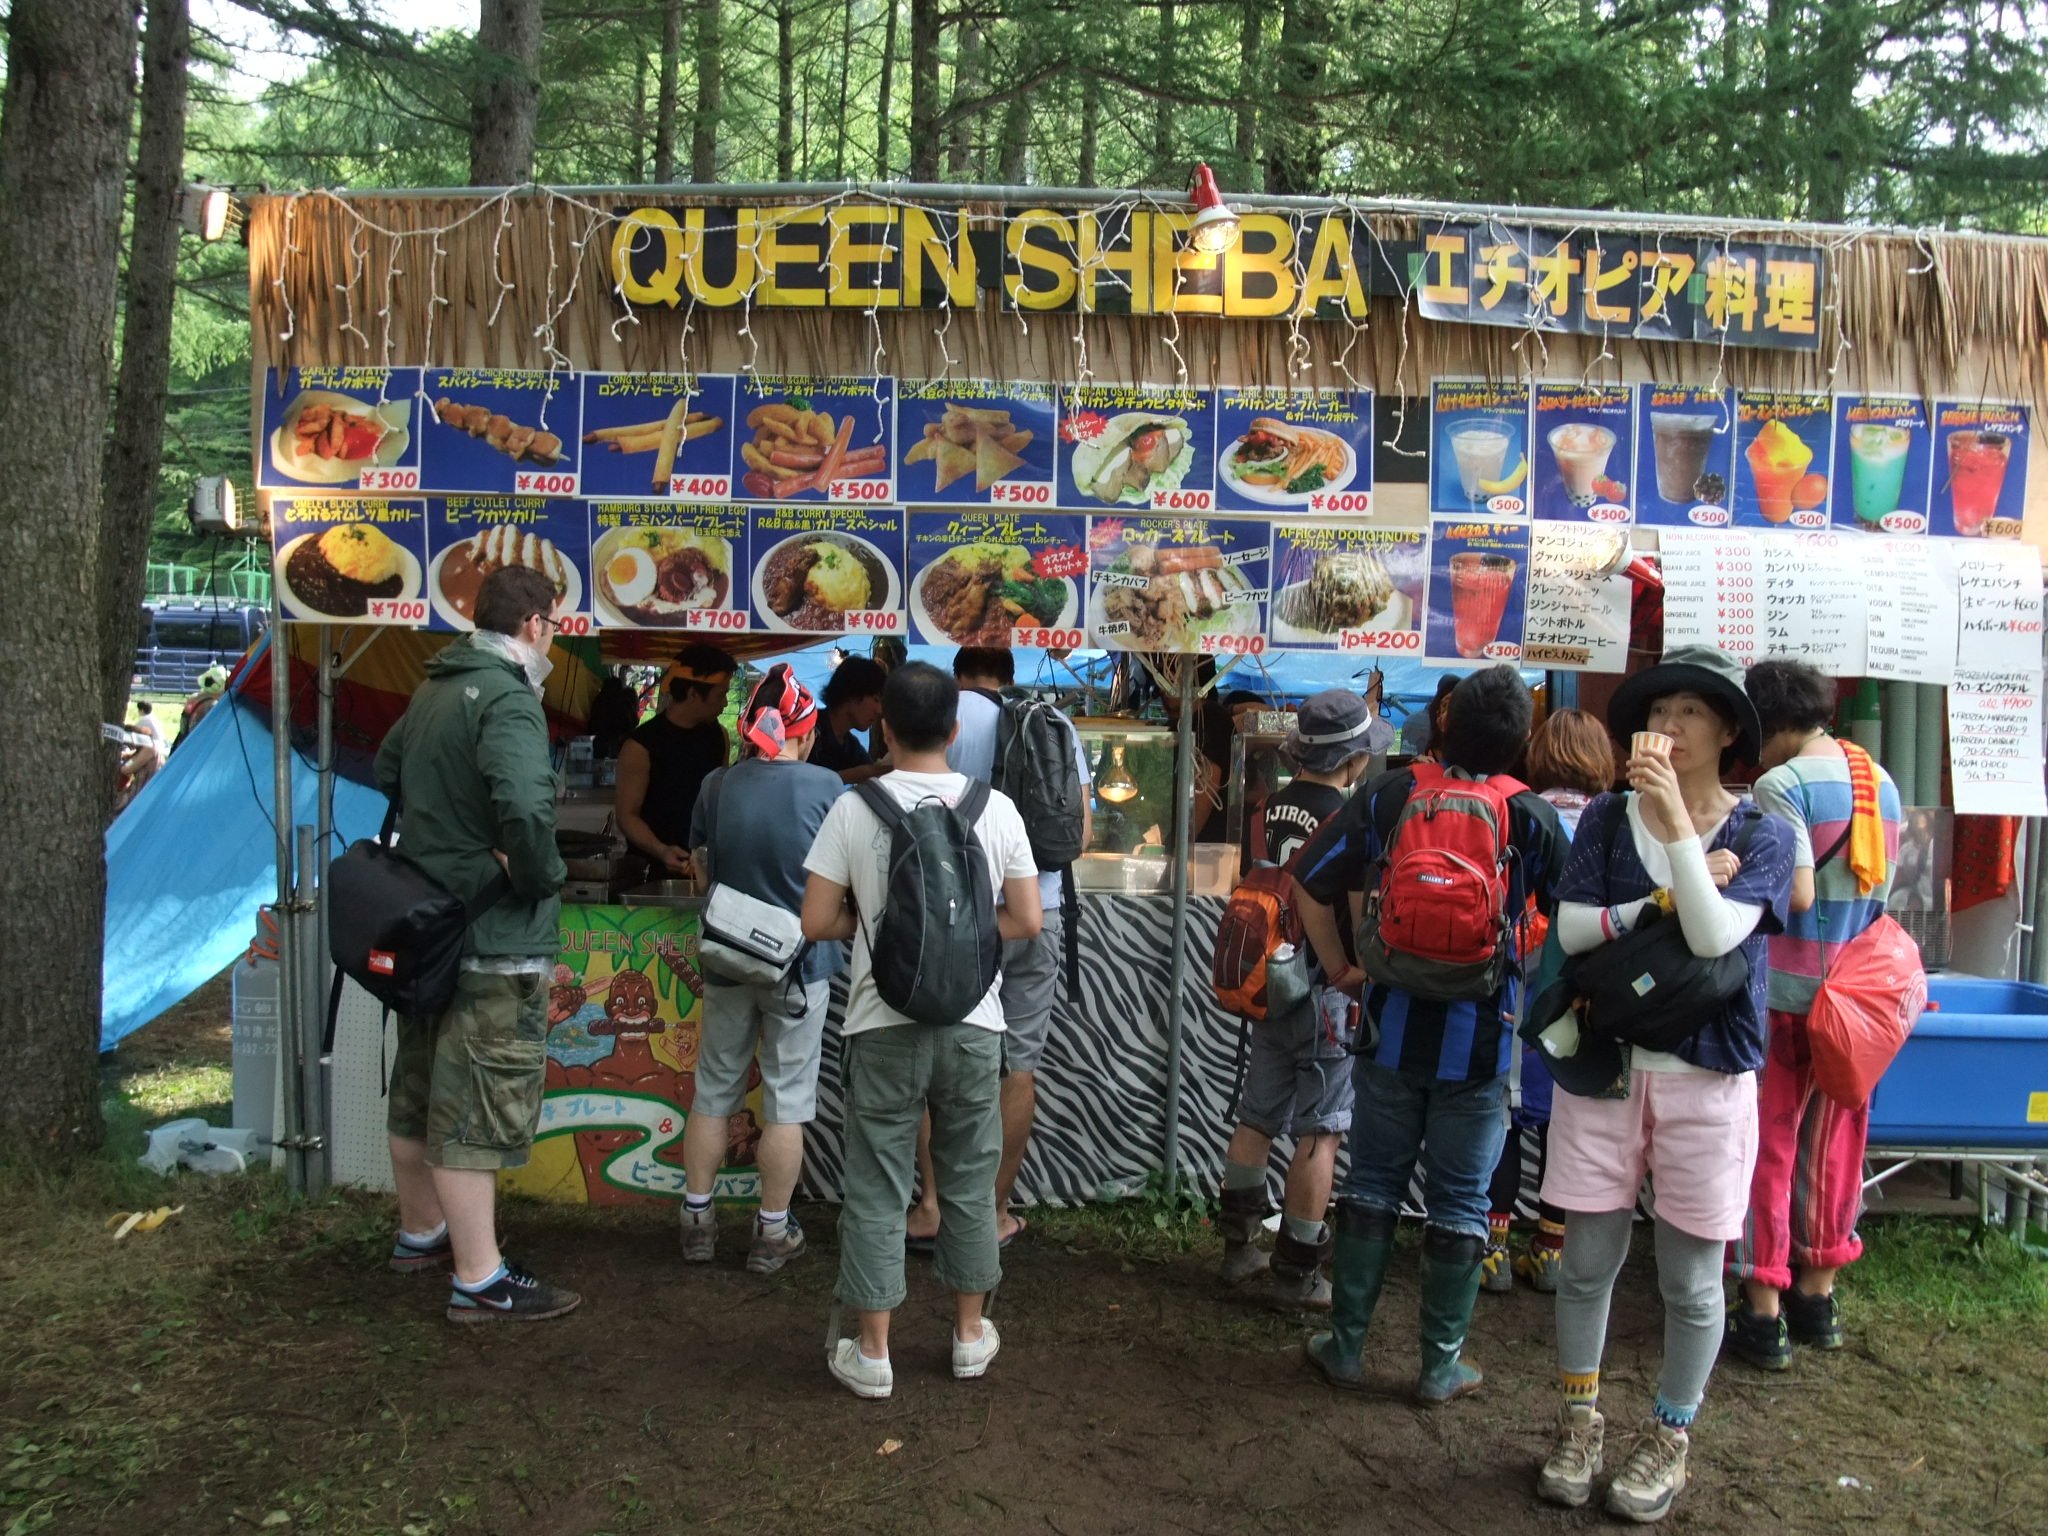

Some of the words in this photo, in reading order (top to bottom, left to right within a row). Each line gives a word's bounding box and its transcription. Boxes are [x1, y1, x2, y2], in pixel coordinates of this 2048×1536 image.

[612, 207, 976, 309] QUEEN
[1003, 208, 1369, 317] SHEBA
[1424, 233, 1816, 334] エチオピア料理
[299, 367, 338, 376] GARLIC
[453, 368, 477, 377] SPICY
[479, 368, 515, 378] CHICKEN
[299, 376, 385, 389] ガーリックポテト
[608, 375, 632, 385] LONG
[635, 376, 675, 385] SAUSAGE
[1111, 388, 1148, 397] OSTRICH
[1152, 389, 1171, 398] PITA
[1238, 390, 1275, 399] AFRICAN
[1302, 391, 1337, 400] BUGER
[1286, 411, 1358, 422] &ガーリックポテト
[362, 472, 417, 490] ¥300
[518, 475, 575, 493] ¥400
[672, 478, 726, 496] ¥400
[831, 482, 888, 499] ¥500
[993, 484, 1049, 502] ¥500
[447, 497, 470, 507] BEEF
[474, 497, 510, 508] CUTLET
[515, 498, 546, 508] CURRY
[1153, 491, 1210, 510] ¥600
[1311, 494, 1368, 511] ¥600
[446, 509, 549, 523] ビーフカツカリー
[598, 504, 641, 513] HAMBURG
[644, 504, 672, 513] STEAK
[676, 505, 697, 513] WITH
[701, 506, 725, 515] FRIED
[728, 507, 746, 515] EGG
[775, 508, 794, 518] R&B
[797, 509, 827, 518] CURRY
[830, 509, 866, 519] SPECIAL
[1591, 510, 1626, 521] ¥500
[597, 514, 621, 526] 特製
[629, 514, 745, 527] デミハンバーグプレート
[961, 514, 989, 523] QUEEN
[994, 514, 1020, 523] PLATE
[1692, 511, 1725, 523] ¥500
[1883, 516, 1921, 530] ¥500
[947, 520, 1046, 537] クィーンプレート
[1141, 519, 1180, 530] ROCKER'S
[1183, 520, 1208, 531] PLATE
[1983, 520, 2021, 535] ¥600
[1279, 528, 1335, 541] AFRICAN
[1339, 529, 1420, 543] DOUGHNUTS
[1291, 539, 1338, 551] アフリカン
[1042, 550, 1074, 565] オススメ
[1223, 548, 1268, 565] ソーセージ
[1714, 547, 1751, 557] ¥300
[1764, 549, 1793, 558] カシス
[1716, 562, 1752, 572] ¥300
[1766, 563, 1805, 573] カンパリ
[1716, 577, 1753, 587] ¥300
[1767, 578, 1794, 588] ディタ
[1224, 590, 1269, 603] ビーフカツ
[1531, 584, 1599, 597] グレープフルーツ
[1717, 592, 1753, 603] ¥300
[1868, 599, 1893, 608] VODKA
[1962, 596, 2010, 609] 生ビール
[371, 601, 424, 619] ¥700
[1529, 599, 1612, 615] ジンジャーエール
[1718, 608, 1754, 619] ¥300
[688, 610, 746, 629] ¥700
[848, 611, 897, 629] ¥900
[1768, 610, 1788, 621] ジン
[1098, 622, 1129, 635] 牛焼肉
[1528, 617, 1585, 629] ペットボトル
[1718, 624, 1754, 635] ¥200
[2009, 619, 2041, 632] ¥600
[1017, 629, 1083, 648] ¥800
[1767, 627, 1788, 637] ラム
[1870, 630, 1885, 638] RUM
[1527, 632, 1617, 646] エチオピアコーヒー
[1718, 640, 1754, 650] ¥200
[1767, 643, 1810, 654] テキーラ
[1869, 662, 1895, 671] MALIBU
[1266, 804, 1319, 836] JIROC
[559, 928, 633, 953] QUEEN
[641, 930, 698, 957] SHEB
[657, 1118, 673, 1134] &
